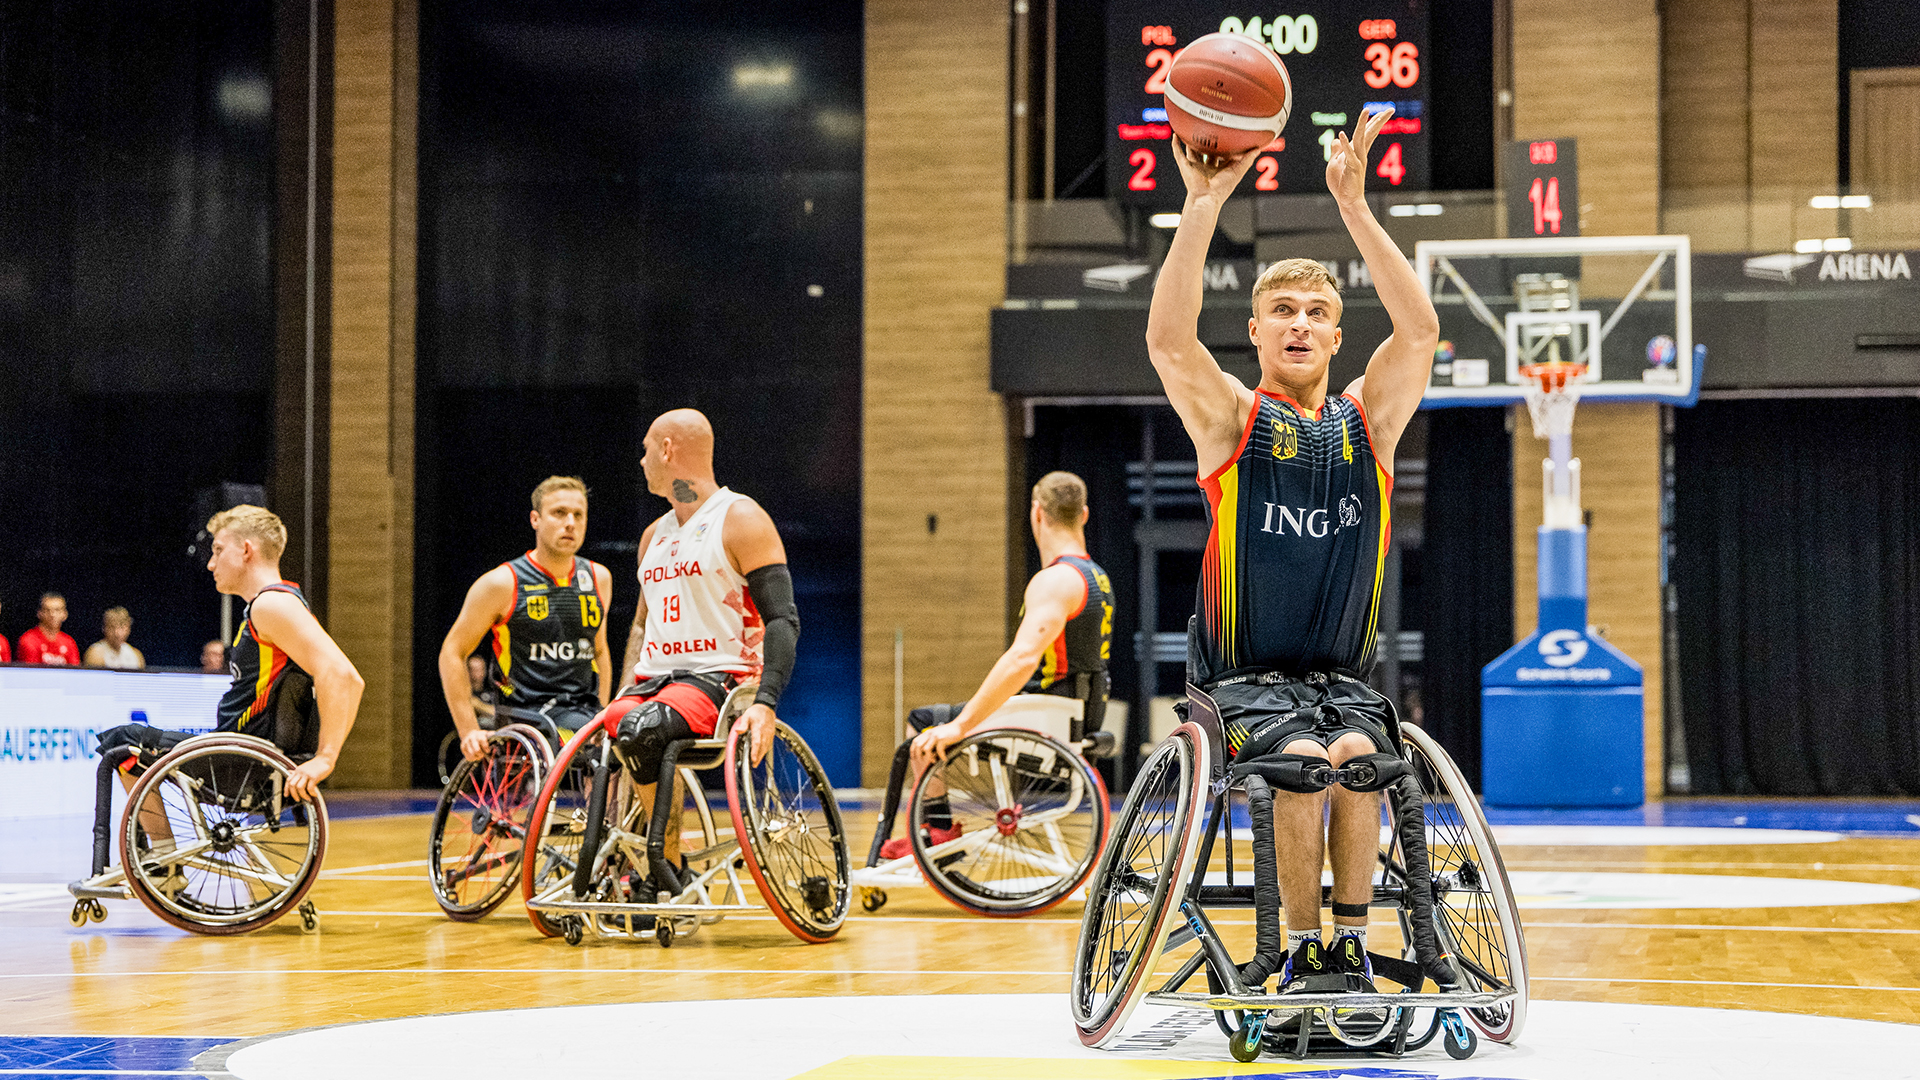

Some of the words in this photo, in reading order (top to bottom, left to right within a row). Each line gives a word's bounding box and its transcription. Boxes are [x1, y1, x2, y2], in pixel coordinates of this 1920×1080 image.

[1141, 25, 1177, 46] POL
[1144, 48, 1184, 94] 2
[1363, 41, 1420, 89] 36
[1128, 148, 1157, 191] 2
[1255, 156, 1279, 191] 2
[1376, 142, 1407, 186] 4
[1528, 176, 1563, 235] 14
[1818, 252, 1912, 281] ARENA
[1260, 501, 1330, 538] ING
[643, 560, 703, 585] POLSKA
[578, 594, 601, 628] 13
[662, 594, 681, 624] 19
[528, 641, 575, 661] ING
[662, 638, 717, 656] ORLEN
[0, 727, 96, 762] AUERFEIND
